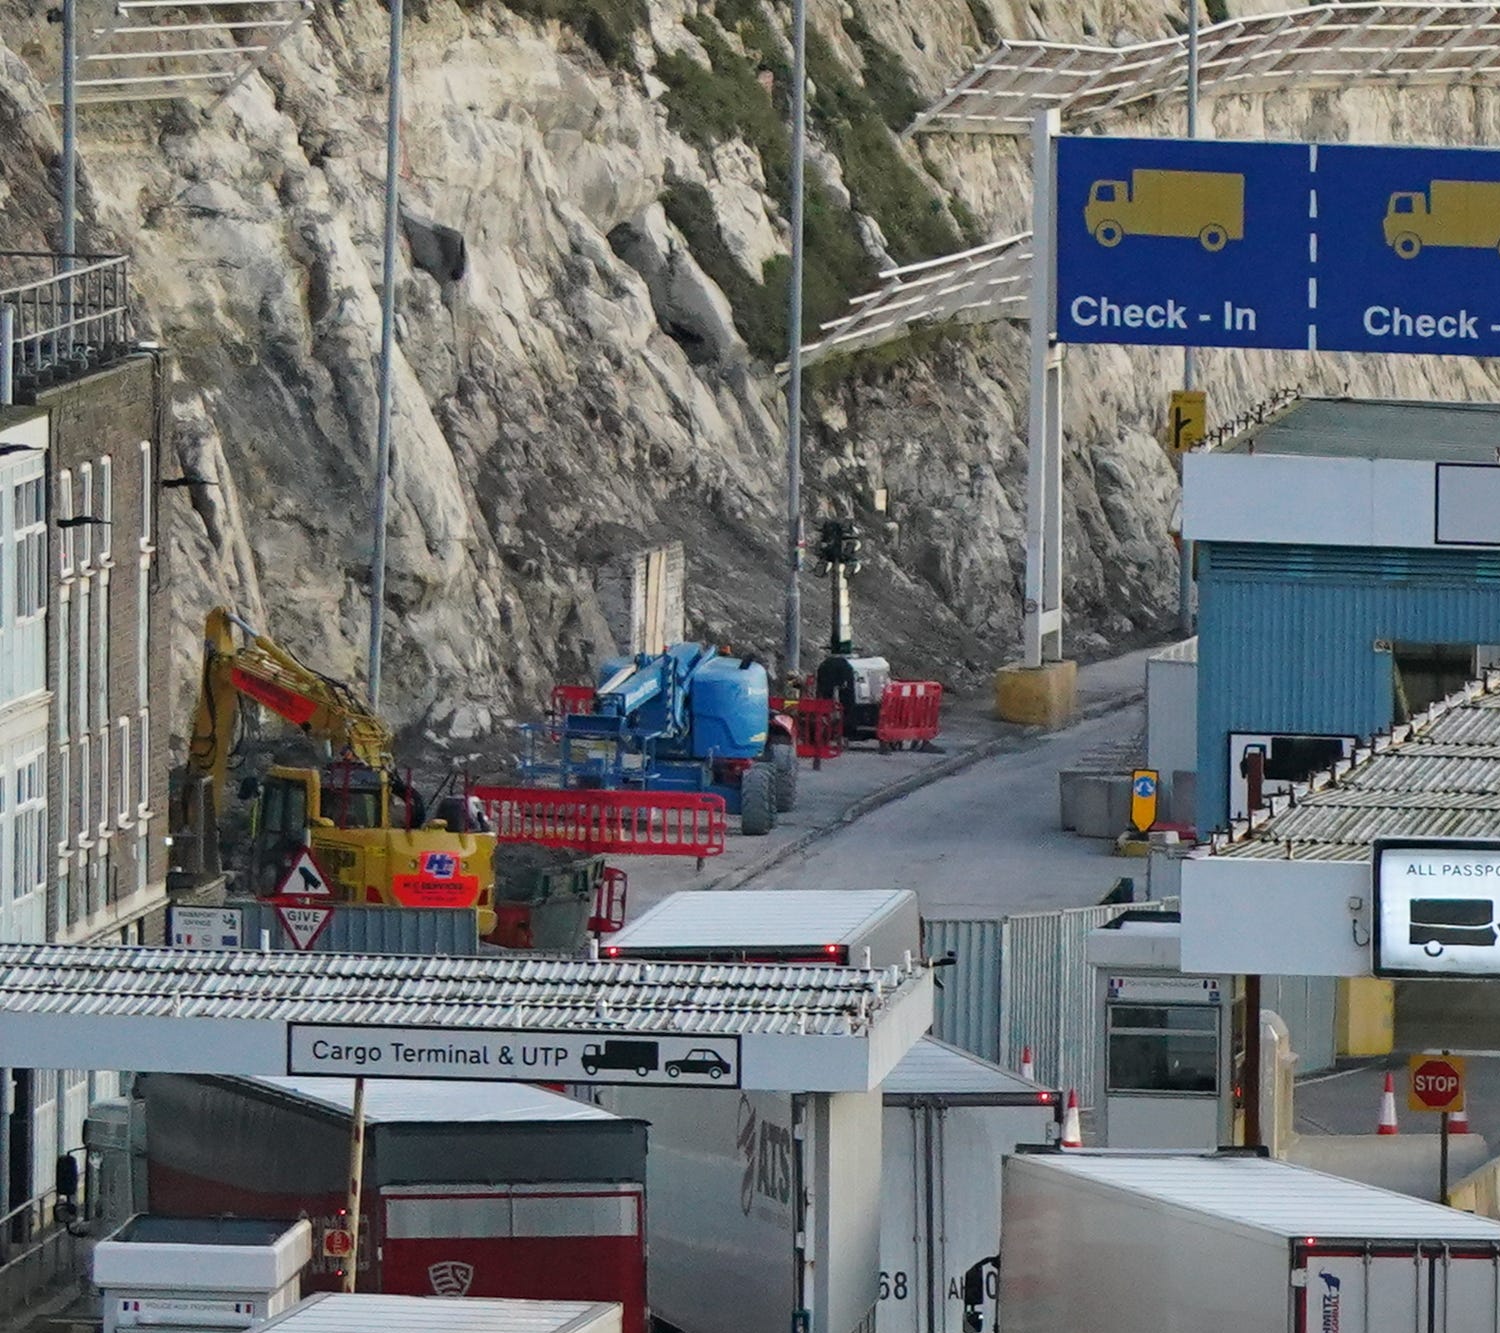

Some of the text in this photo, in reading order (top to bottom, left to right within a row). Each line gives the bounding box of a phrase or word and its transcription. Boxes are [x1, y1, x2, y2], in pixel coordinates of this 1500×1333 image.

[1070, 295, 1256, 331] Check In
[1363, 306, 1478, 340] Check
[1407, 864, 1436, 877] ALL
[287, 910, 320, 923] GIVE
[294, 924, 314, 933] WAY
[312, 1040, 568, 1067] Cargo Terminal & UTP
[1415, 1076, 1457, 1092] STOP
